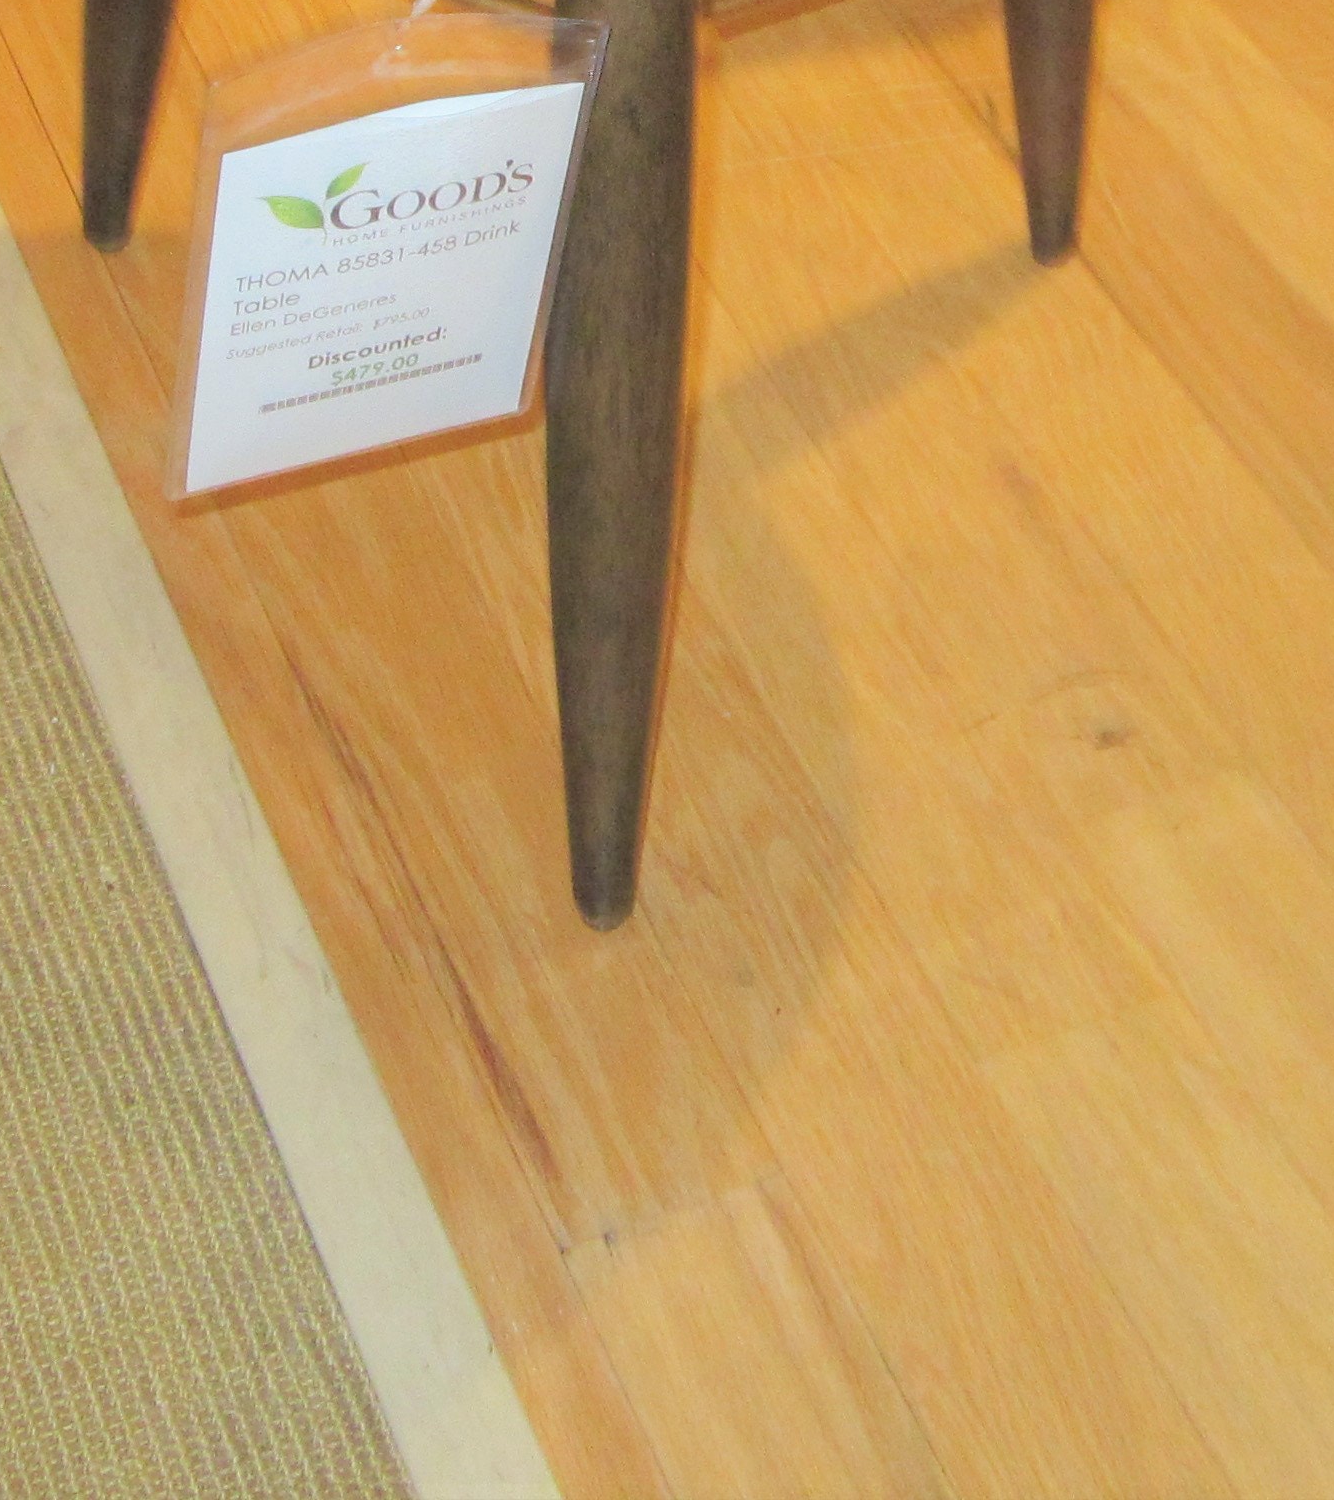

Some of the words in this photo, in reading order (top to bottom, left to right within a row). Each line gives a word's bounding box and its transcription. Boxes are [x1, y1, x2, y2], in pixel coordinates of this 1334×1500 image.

[329, 159, 534, 231] GOOD'S
[332, 228, 389, 248] HOME
[399, 196, 528, 234] FURNISHINGS
[235, 262, 329, 293] THOMA
[337, 236, 458, 275] 85831-458
[463, 219, 521, 247] Drink
[229, 311, 277, 337] Ellen
[283, 291, 397, 327] DeGeneres
[233, 291, 301, 317] Table
[225, 331, 312, 361] Suggested
[315, 321, 364, 343] Retail:
[307, 325, 448, 370] Discounted:
[330, 352, 420, 388] $479.00
